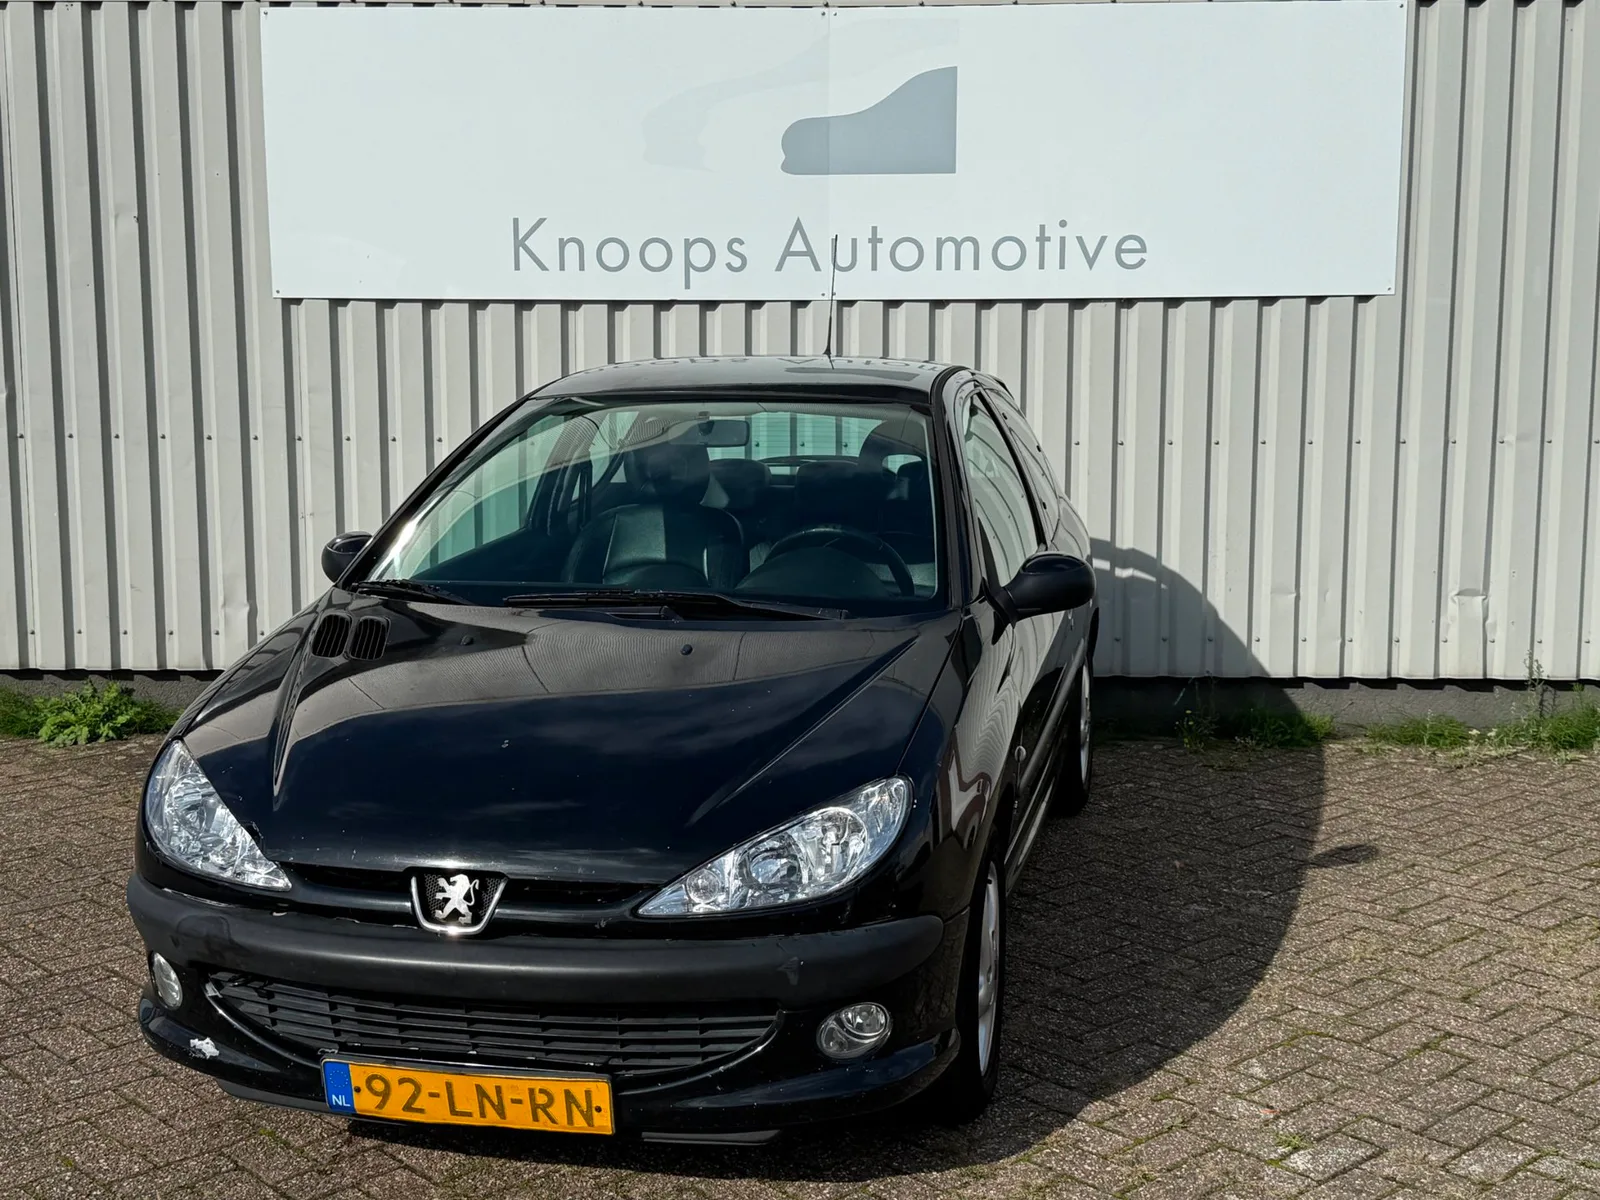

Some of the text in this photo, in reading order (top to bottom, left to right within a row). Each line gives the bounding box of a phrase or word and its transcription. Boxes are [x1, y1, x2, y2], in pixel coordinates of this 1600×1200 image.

[512, 217, 1148, 290] Knoops Automotive
[332, 1073, 595, 1128] NL 92-LN-RN
